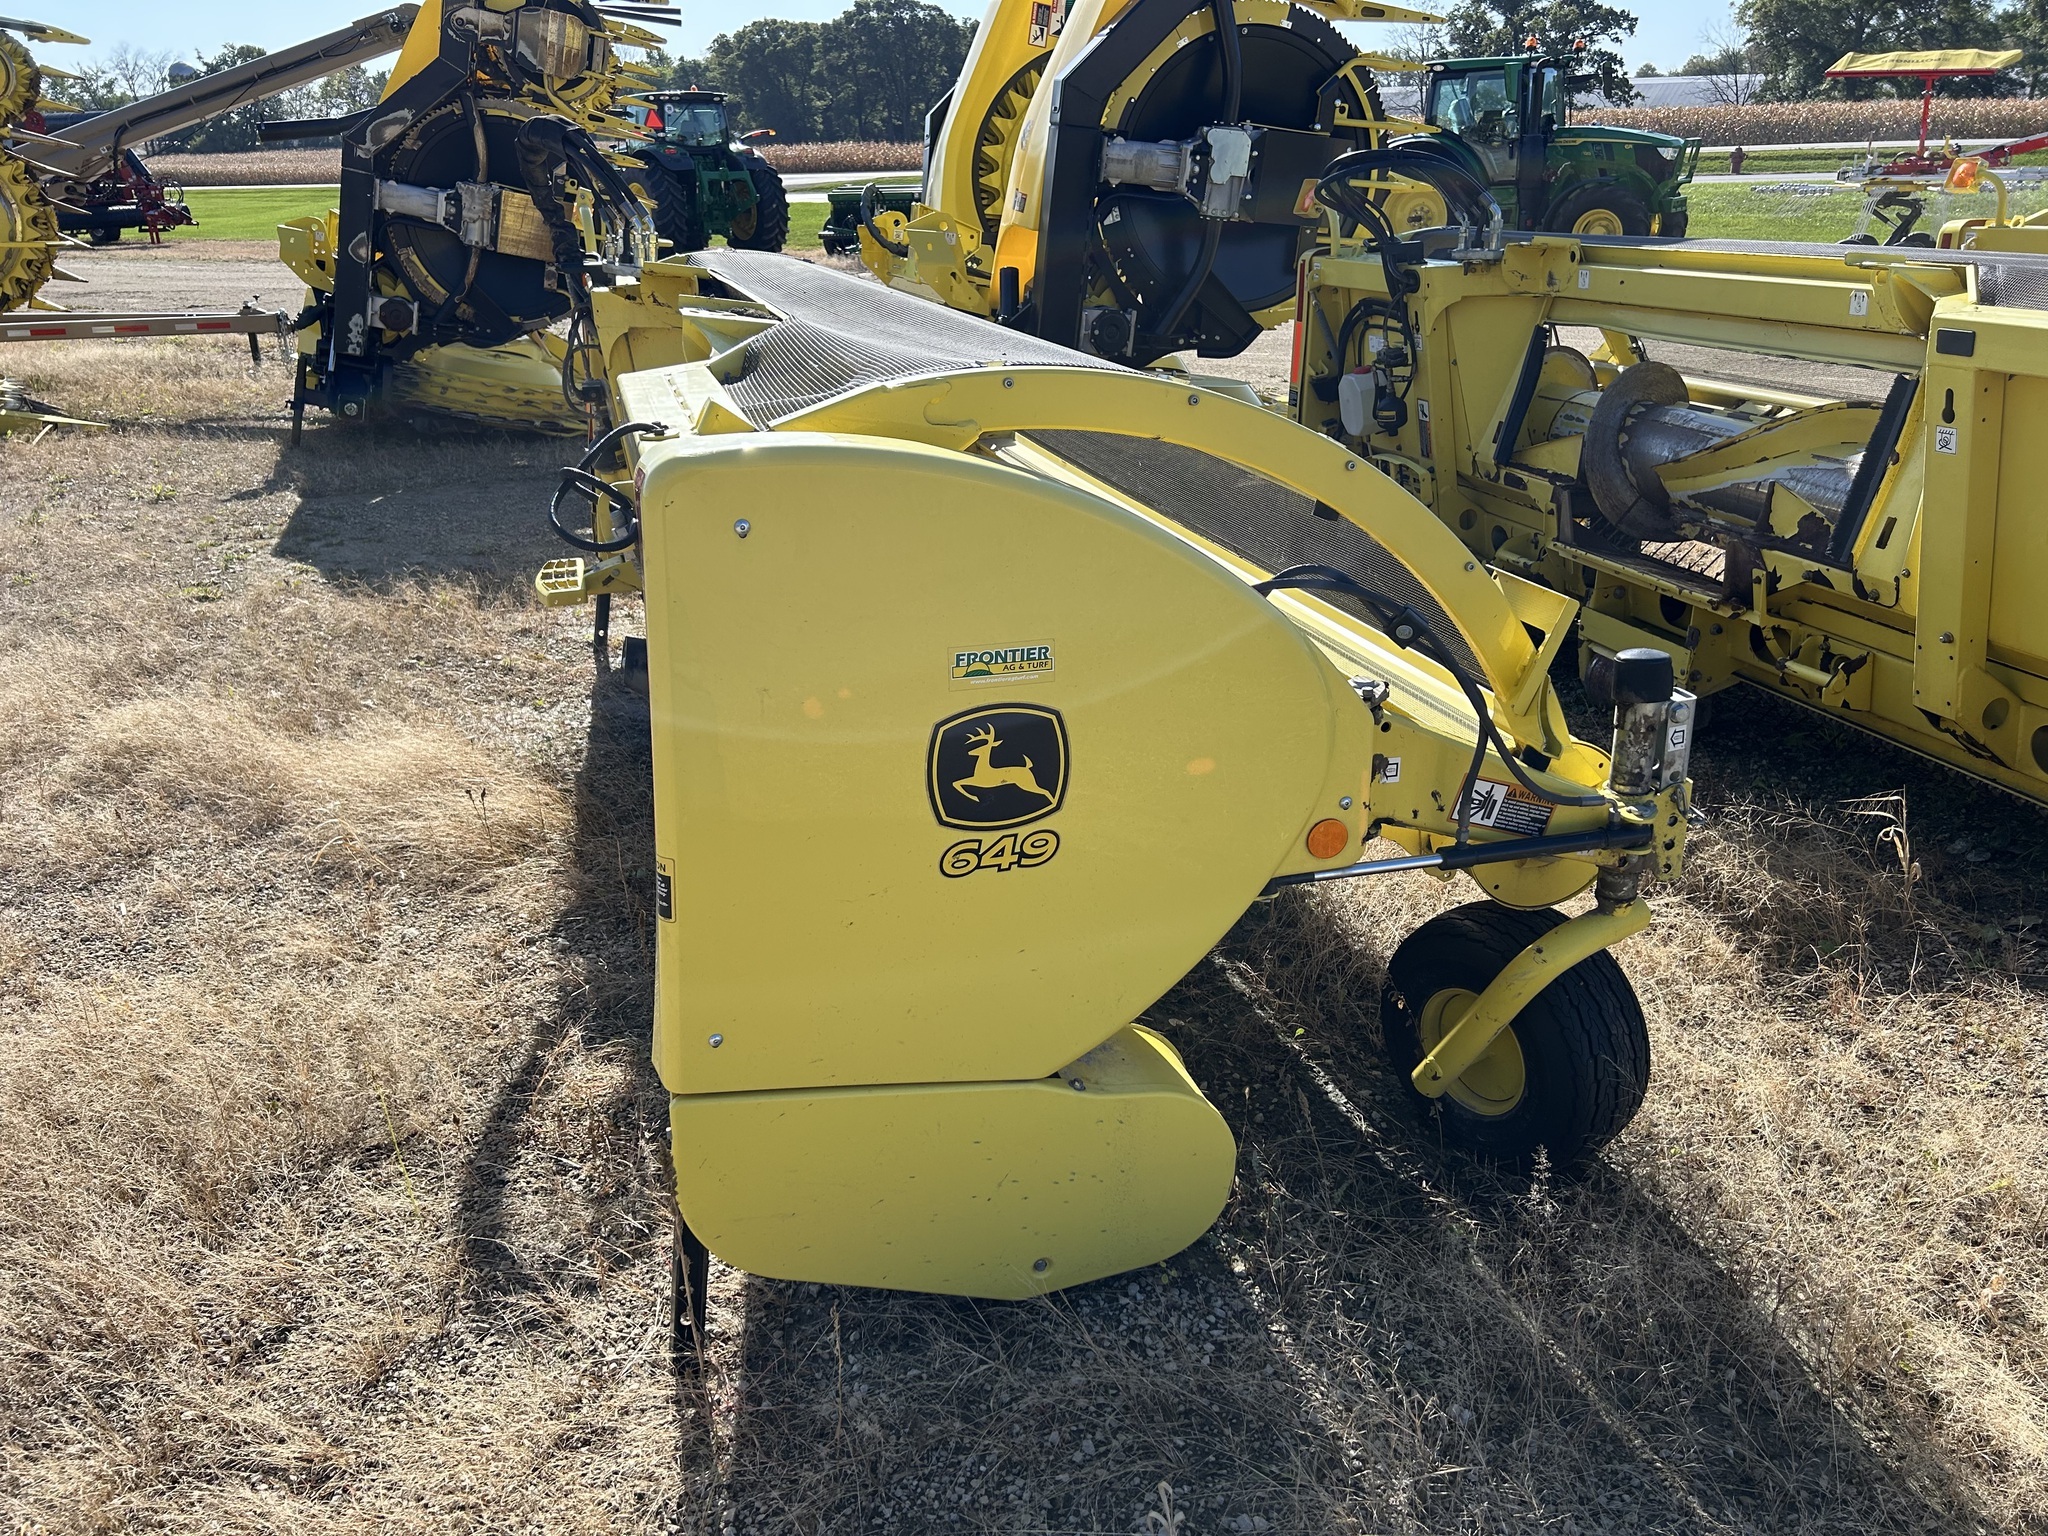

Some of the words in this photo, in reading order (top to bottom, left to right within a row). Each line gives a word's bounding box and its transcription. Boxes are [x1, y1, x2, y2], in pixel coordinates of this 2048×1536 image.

[955, 646, 1050, 667] FRONTIER
[1027, 661, 1050, 669] TURF
[939, 829, 1060, 879] 649
